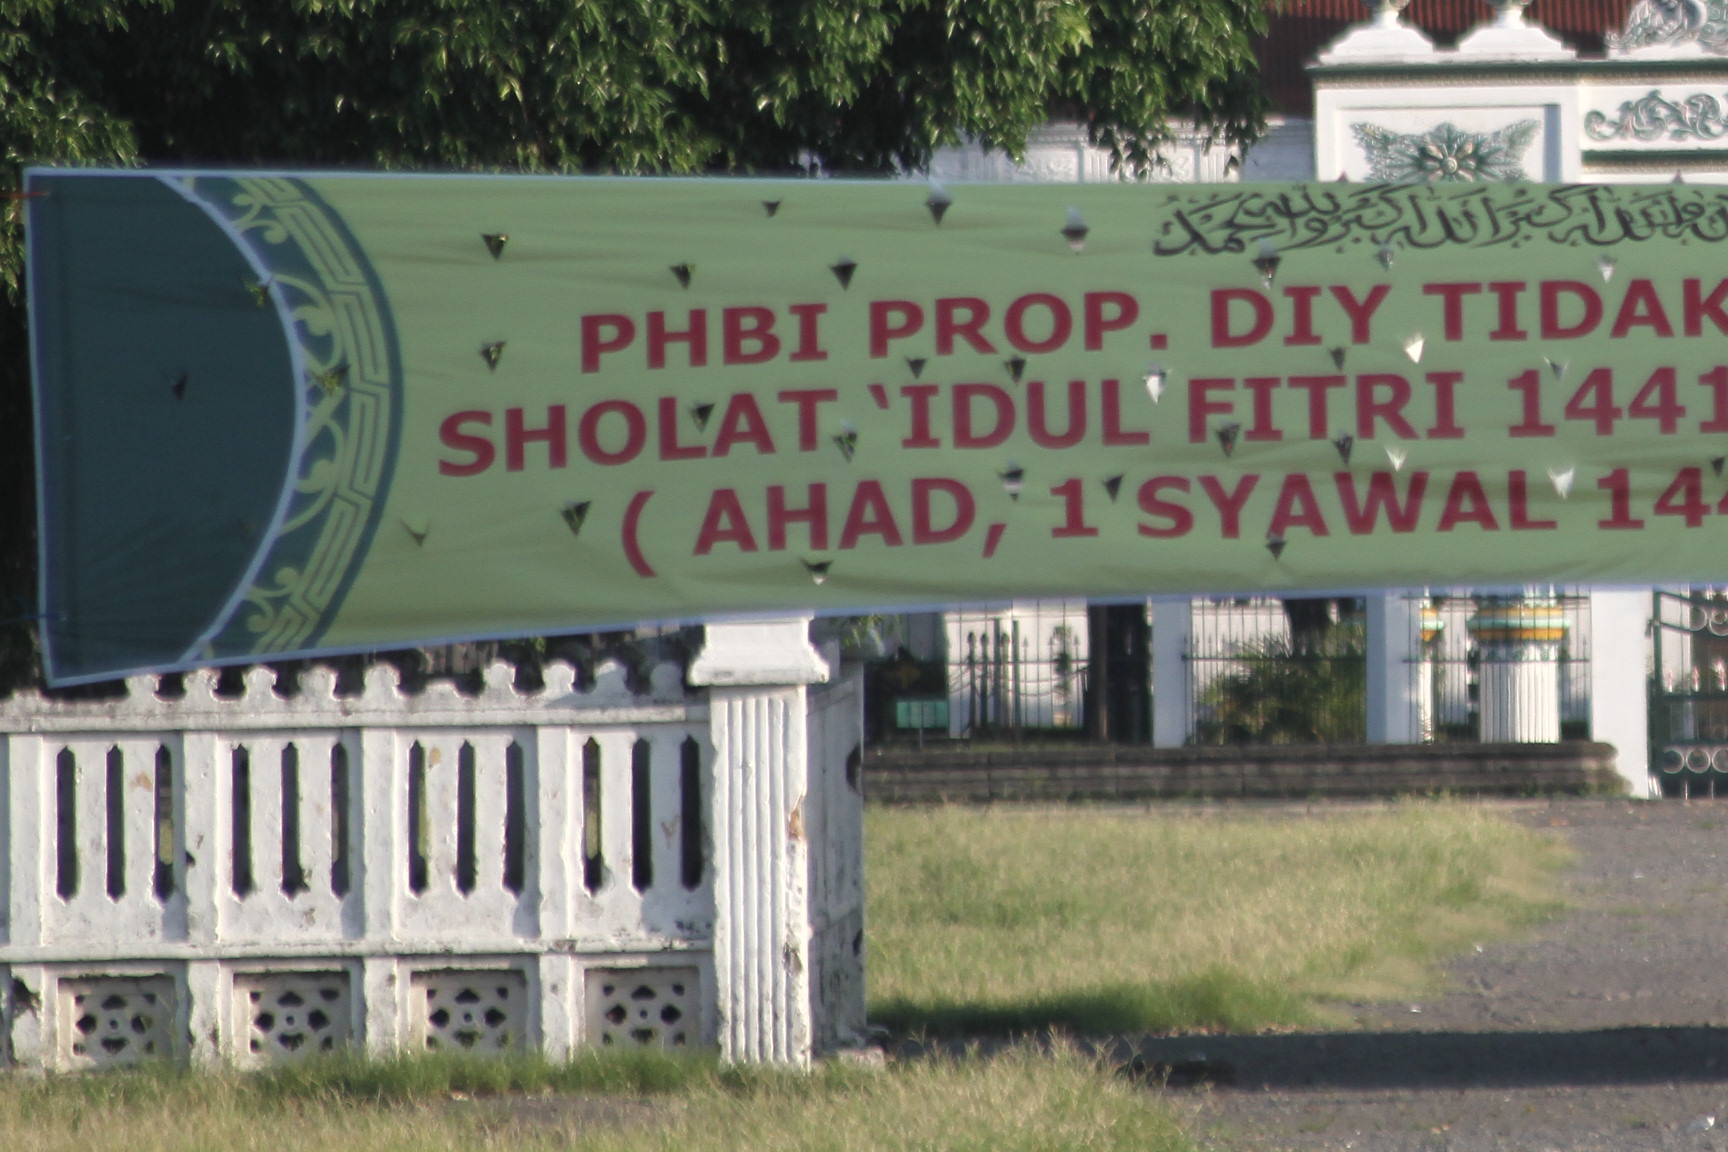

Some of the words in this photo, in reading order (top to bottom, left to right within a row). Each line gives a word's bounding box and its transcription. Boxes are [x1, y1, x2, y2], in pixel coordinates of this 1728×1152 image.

[581, 302, 828, 373] PHBI
[869, 290, 1168, 358] PROP.
[1210, 283, 1392, 348] DIY
[439, 388, 838, 477] SHOLAT
[1188, 370, 1464, 443] FITRI
[694, 477, 1006, 557] AHAD,
[1051, 477, 1098, 538] 1
[1137, 469, 1557, 539] SYAWAL
